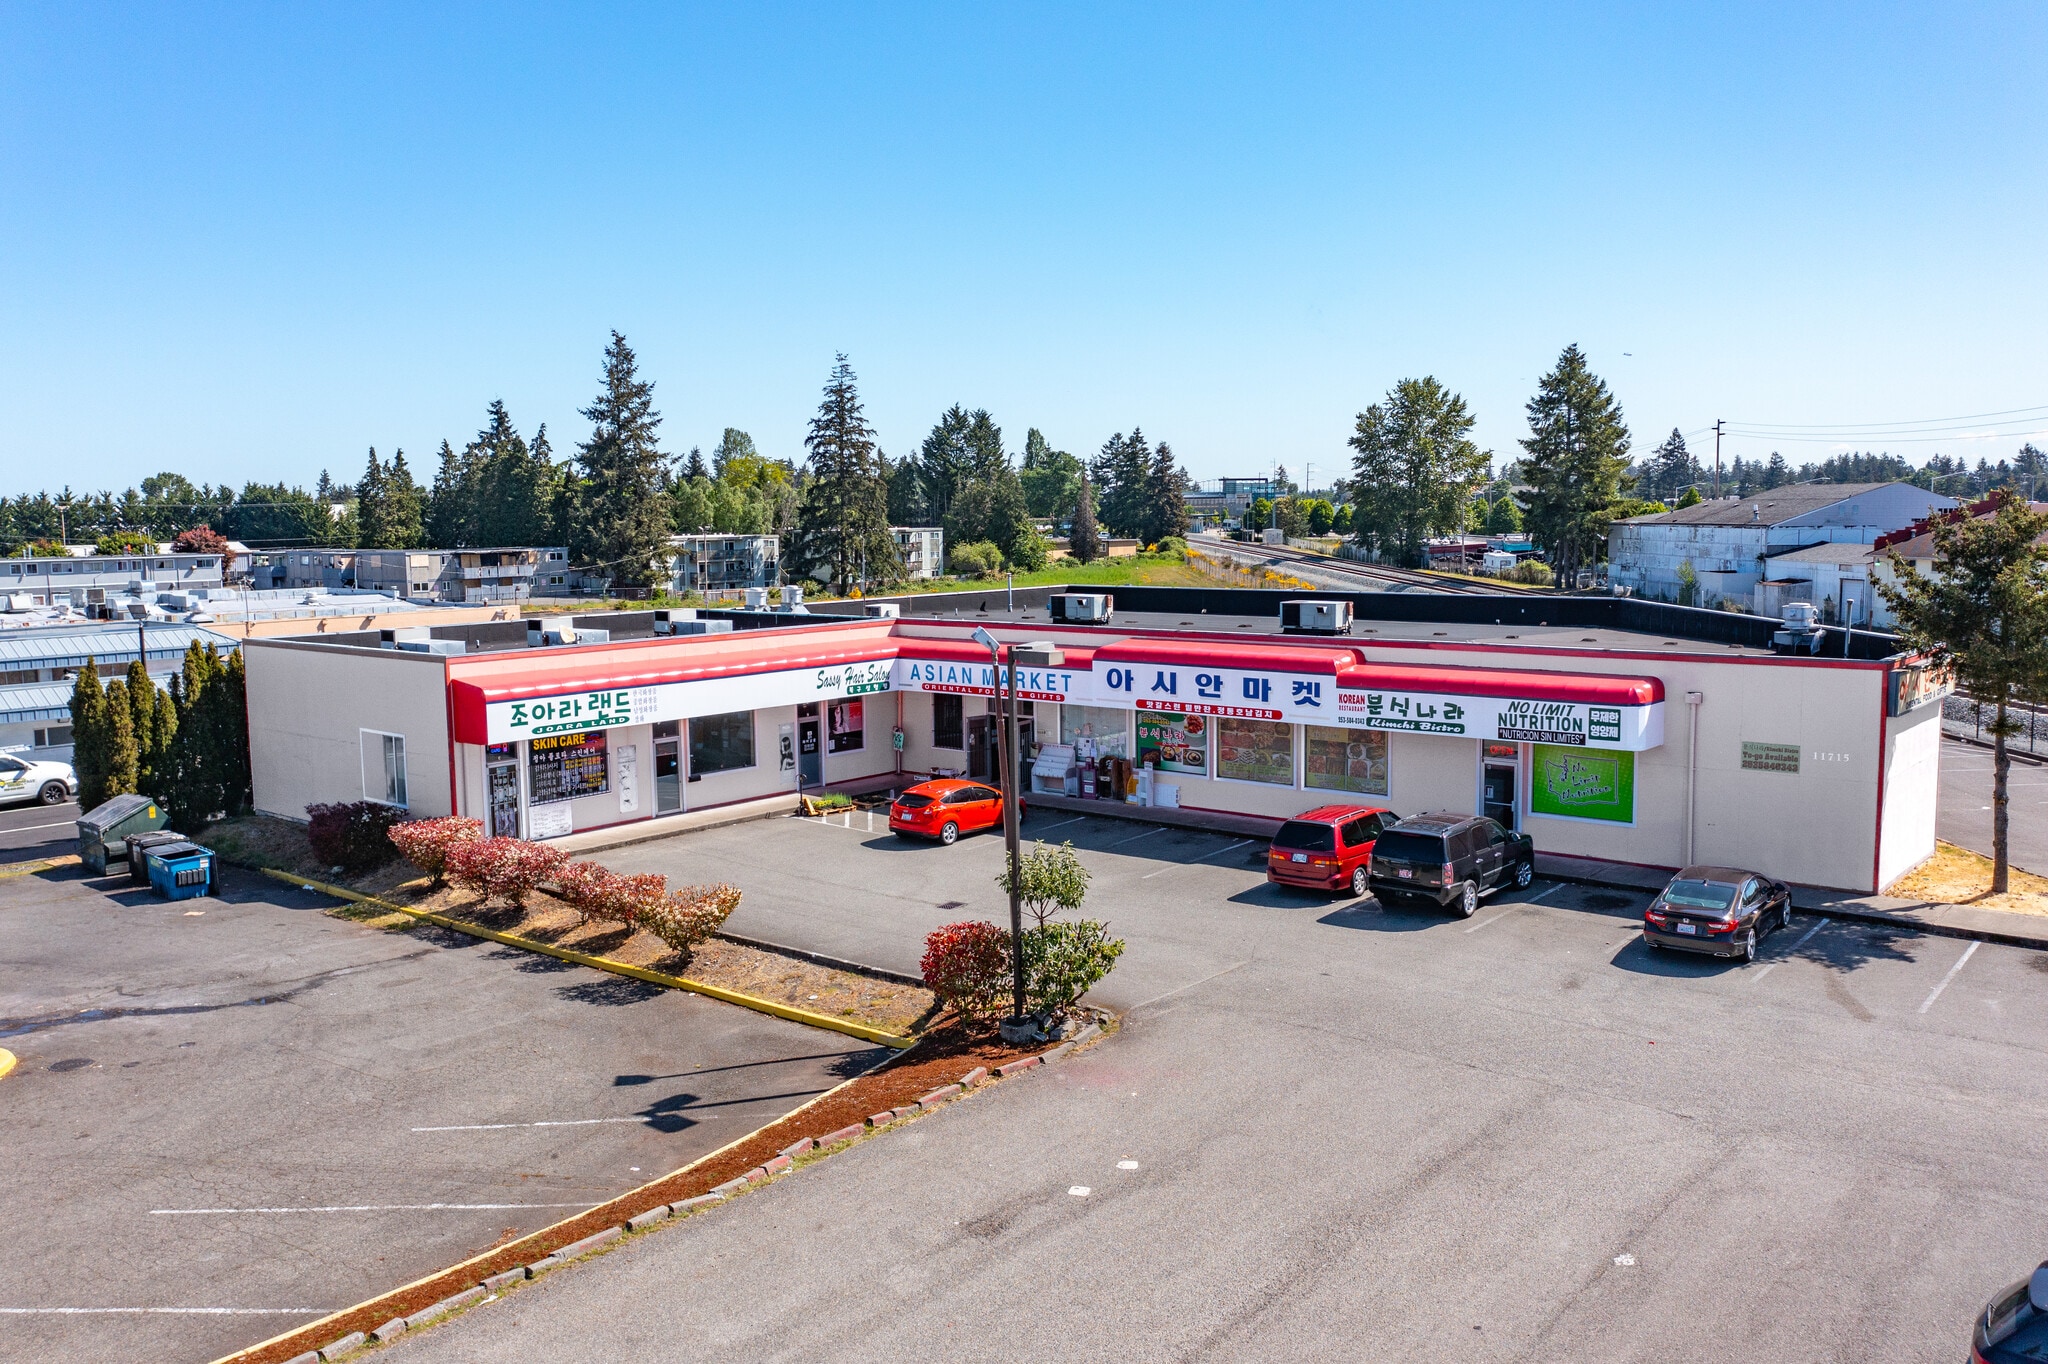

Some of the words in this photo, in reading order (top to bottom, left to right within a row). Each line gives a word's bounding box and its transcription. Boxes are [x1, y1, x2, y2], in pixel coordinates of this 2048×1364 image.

[817, 670, 841, 690] Sassy
[845, 667, 865, 685] Hair
[867, 664, 890, 682] Salon
[910, 664, 972, 685] ASIAN
[982, 668, 1072, 692] MARKET
[925, 684, 972, 693] ORIENTAL
[1030, 693, 1061, 701] GIFTS
[1338, 693, 1365, 705] KOREAN
[1339, 704, 1365, 712] RESTAURANT
[1367, 694, 1465, 720] 분식나라
[1508, 701, 1530, 714] NO
[1532, 703, 1576, 716] LIMIT
[1498, 713, 1583, 732] NUTRITION
[1590, 710, 1619, 724] 무제한
[536, 722, 584, 734] JOARA
[591, 716, 626, 728] LAND
[1370, 718, 1415, 729] Kimchi
[1419, 722, 1461, 733] Bistro
[1590, 725, 1619, 738] 영양제
[533, 737, 557, 750] SKIN
[559, 733, 586, 747] CARE
[1540, 732, 1553, 741] SIN
[1489, 745, 1514, 755] OPEN
[1743, 751, 1763, 760] To-go
[1764, 753, 1799, 763] Available
[1813, 752, 1850, 762] 11715
[1572, 762, 1587, 773] No
[1571, 774, 1600, 787] Limit
[1562, 786, 1611, 800] Nutrition
